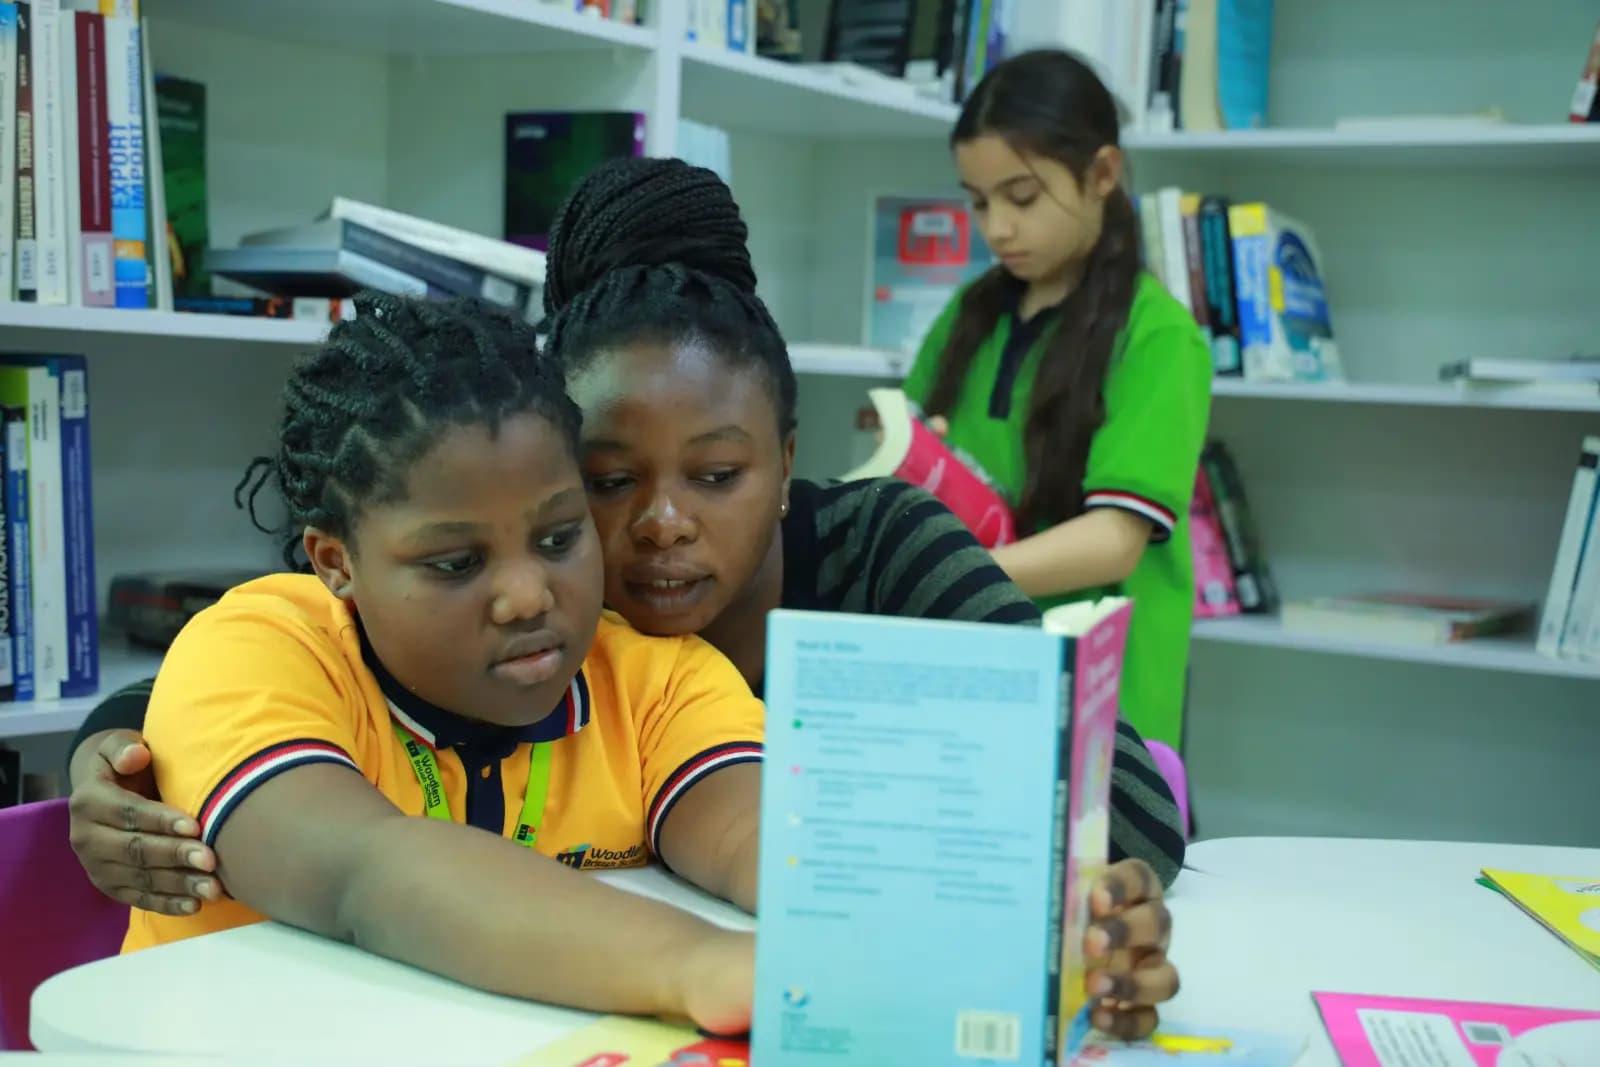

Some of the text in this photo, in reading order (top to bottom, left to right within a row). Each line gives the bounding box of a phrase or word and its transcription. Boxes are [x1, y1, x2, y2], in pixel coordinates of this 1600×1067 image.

[108, 122, 129, 209] EXPORT
[130, 122, 145, 209] IMPORT
[0, 513, 9, 636] INNOVATION
[415, 760, 428, 783] British
[422, 755, 440, 806] Woodlem
